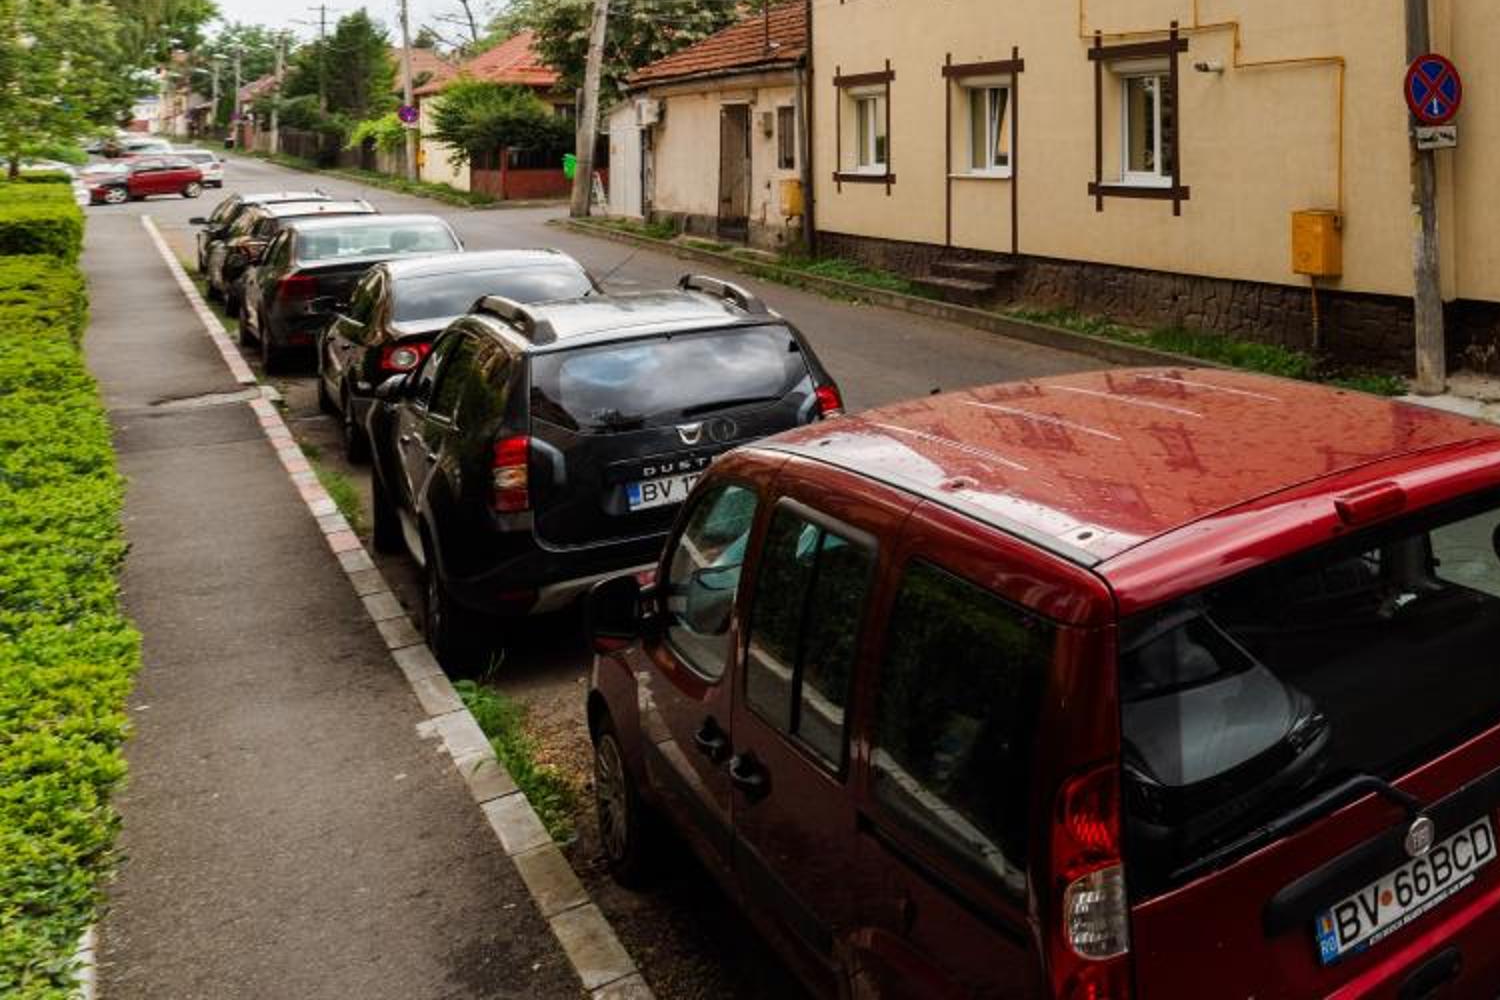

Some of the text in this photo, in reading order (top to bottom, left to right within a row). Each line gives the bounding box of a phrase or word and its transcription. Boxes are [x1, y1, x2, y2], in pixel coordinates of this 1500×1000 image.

[642, 480, 672, 502] BV
[1334, 885, 1380, 945] BV
[1394, 823, 1492, 907] 66BCD
